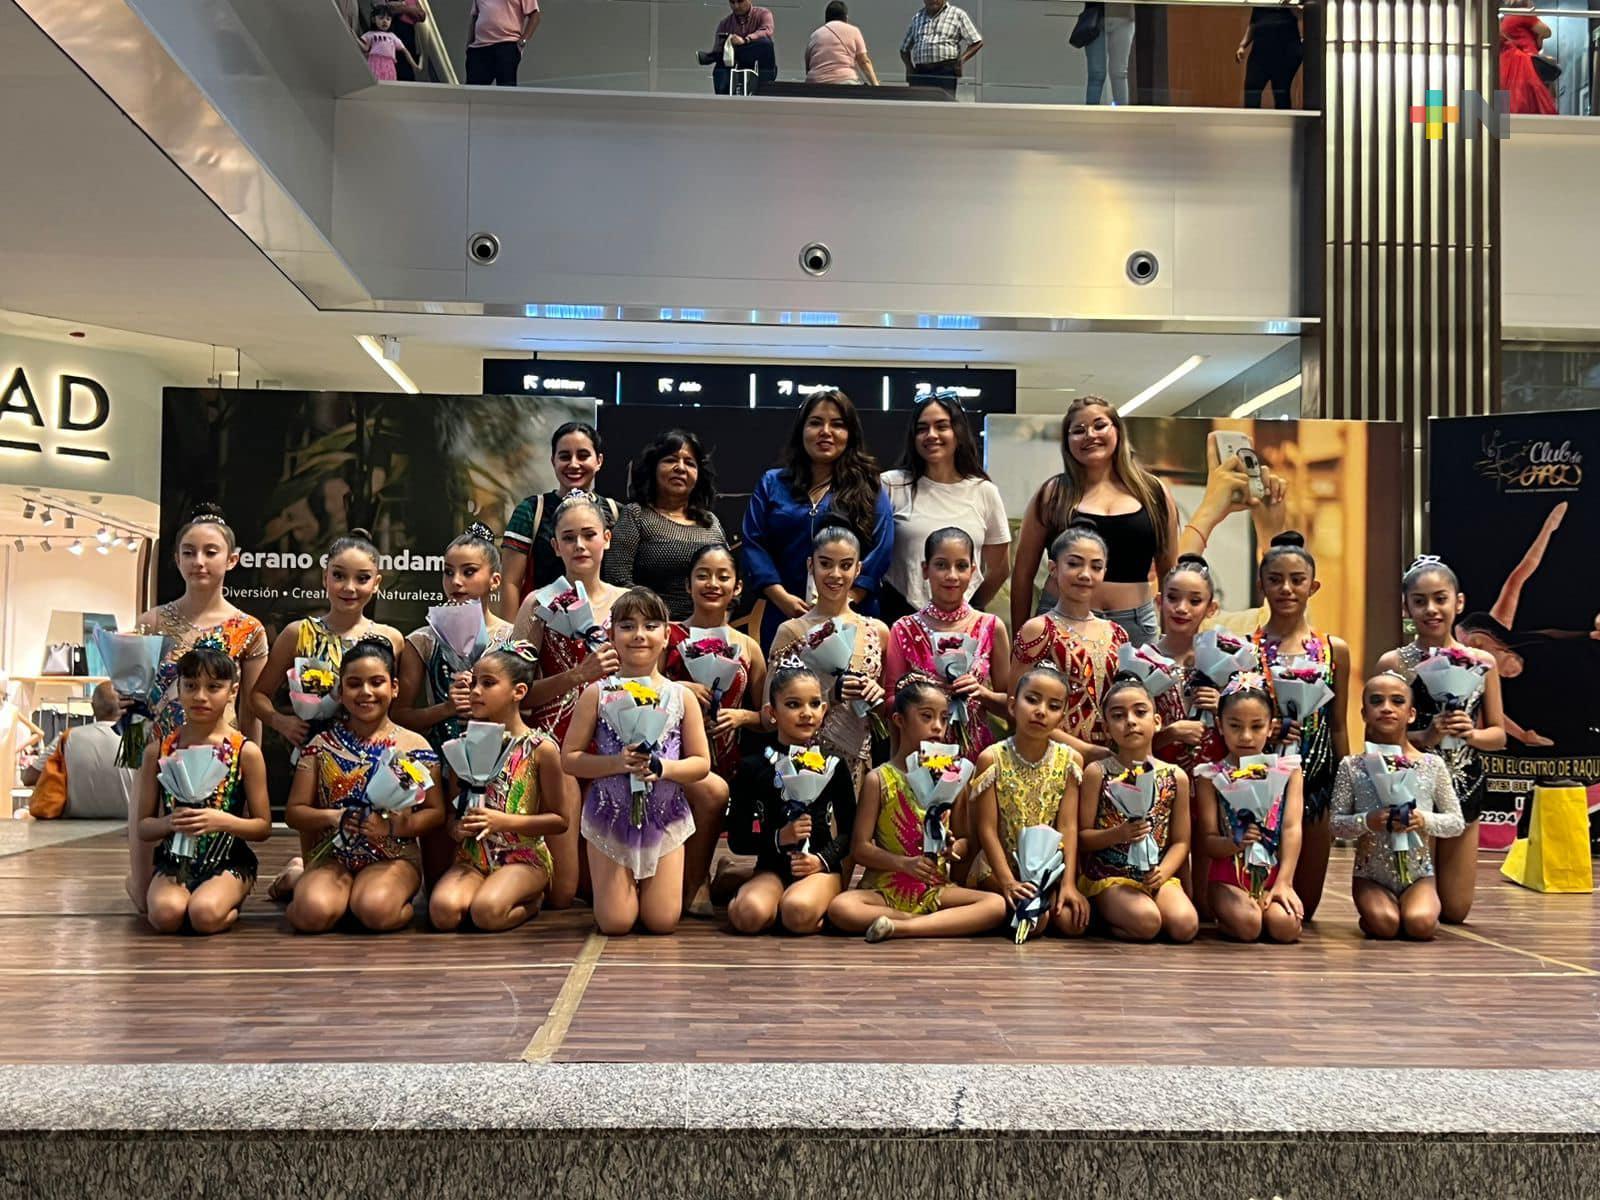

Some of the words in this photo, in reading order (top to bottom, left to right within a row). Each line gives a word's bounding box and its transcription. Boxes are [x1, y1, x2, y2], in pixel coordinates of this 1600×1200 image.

[1529, 440, 1570, 463] Club
[234, 547, 314, 569] erano
[222, 586, 279, 598] Diversión
[377, 589, 443, 601] Naturaleza
[1491, 757, 1505, 773] EN
[1506, 759, 1518, 774] EL
[1519, 760, 1556, 776] CENTRO
[1557, 760, 1571, 776] DE
